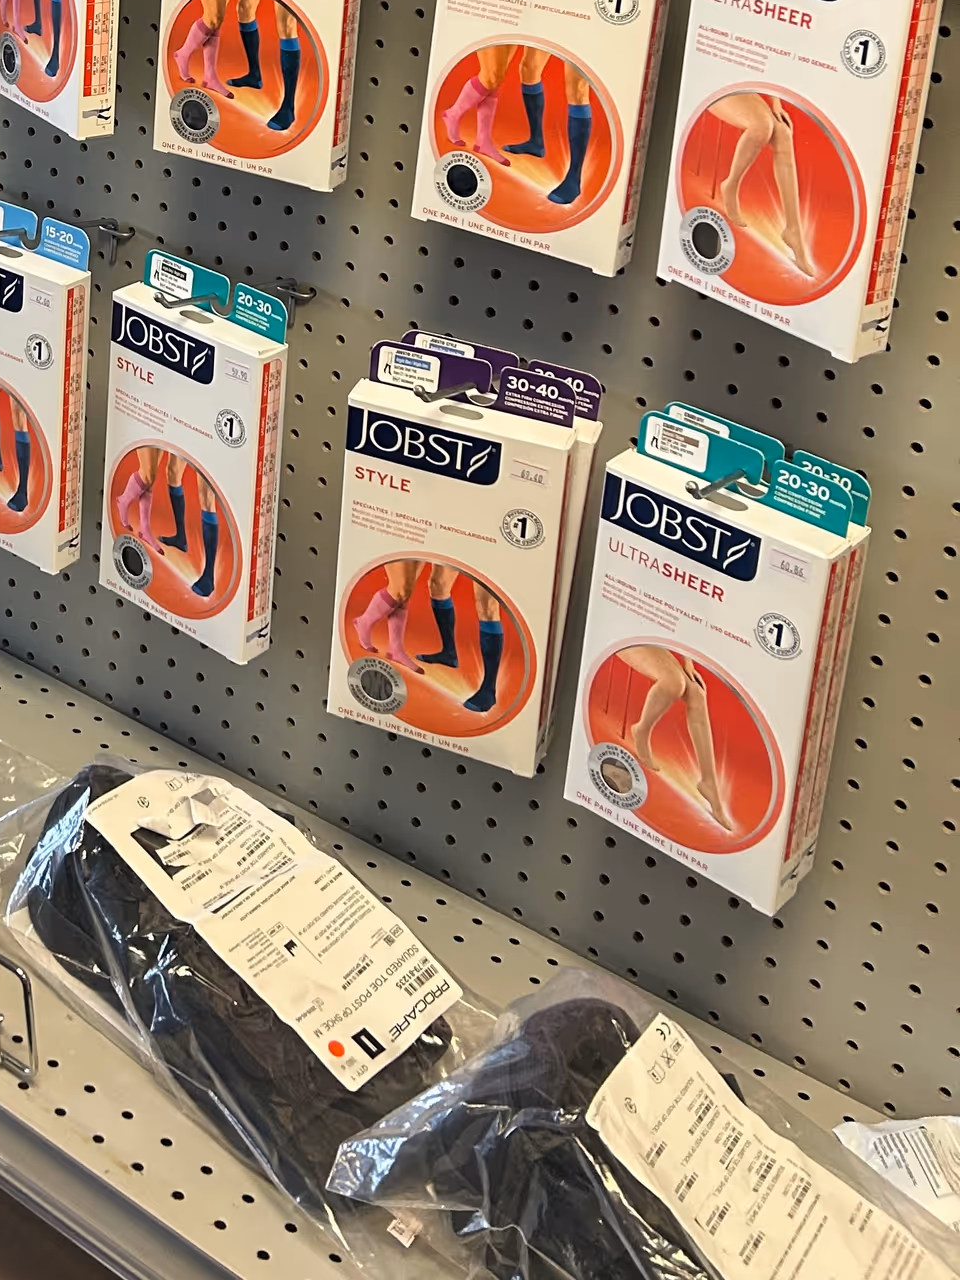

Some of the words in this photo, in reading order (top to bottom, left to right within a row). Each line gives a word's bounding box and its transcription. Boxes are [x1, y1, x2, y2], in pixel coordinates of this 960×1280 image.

[162, 142, 176, 150] ONE
[178, 145, 193, 155] PAIR
[201, 151, 217, 160] UNE
[217, 154, 237, 166] PAIRE
[246, 162, 257, 171] UN
[258, 165, 273, 174] PAR
[45, 225, 73, 245] 15-20
[422, 207, 438, 217] ONE
[440, 211, 458, 223] PAIR
[468, 221, 484, 231] UNE
[486, 226, 510, 239] PAIRE
[520, 236, 532, 246] UN
[534, 240, 551, 251] PAR
[237, 291, 272, 316] 20-30
[667, 265, 683, 278] ONE
[684, 272, 702, 286] PAIR
[711, 285, 727, 298] UNE
[728, 292, 751, 309] PAIRE
[760, 307, 773, 318] UN
[774, 313, 791, 326] PAR
[117, 305, 196, 369] JOBST
[117, 357, 155, 385] STYLE
[507, 375, 559, 400] 30-40
[354, 409, 473, 470] JOBST
[355, 467, 411, 493] STYLE
[777, 469, 830, 501] 20-30
[610, 477, 732, 561] JOBST
[608, 536, 725, 603] ULTRASHEER
[338, 706, 354, 717] ONE
[356, 711, 375, 723] PAIR
[385, 722, 401, 734] UNE
[403, 726, 428, 741] PAIRE
[438, 738, 451, 747] UN
[452, 742, 469, 754] PAR
[576, 791, 592, 805] ONE
[594, 800, 613, 817] PAIR
[623, 818, 639, 832] UNE
[641, 828, 666, 847] PAIRE
[676, 848, 689, 861] UN
[691, 855, 709, 872] PAR
[385, 944, 420, 976] SQUARED
[370, 974, 388, 992] TOE
[343, 1007, 353, 1018] OP
[352, 989, 373, 1011] POST
[388, 979, 450, 1041] PROCARE
